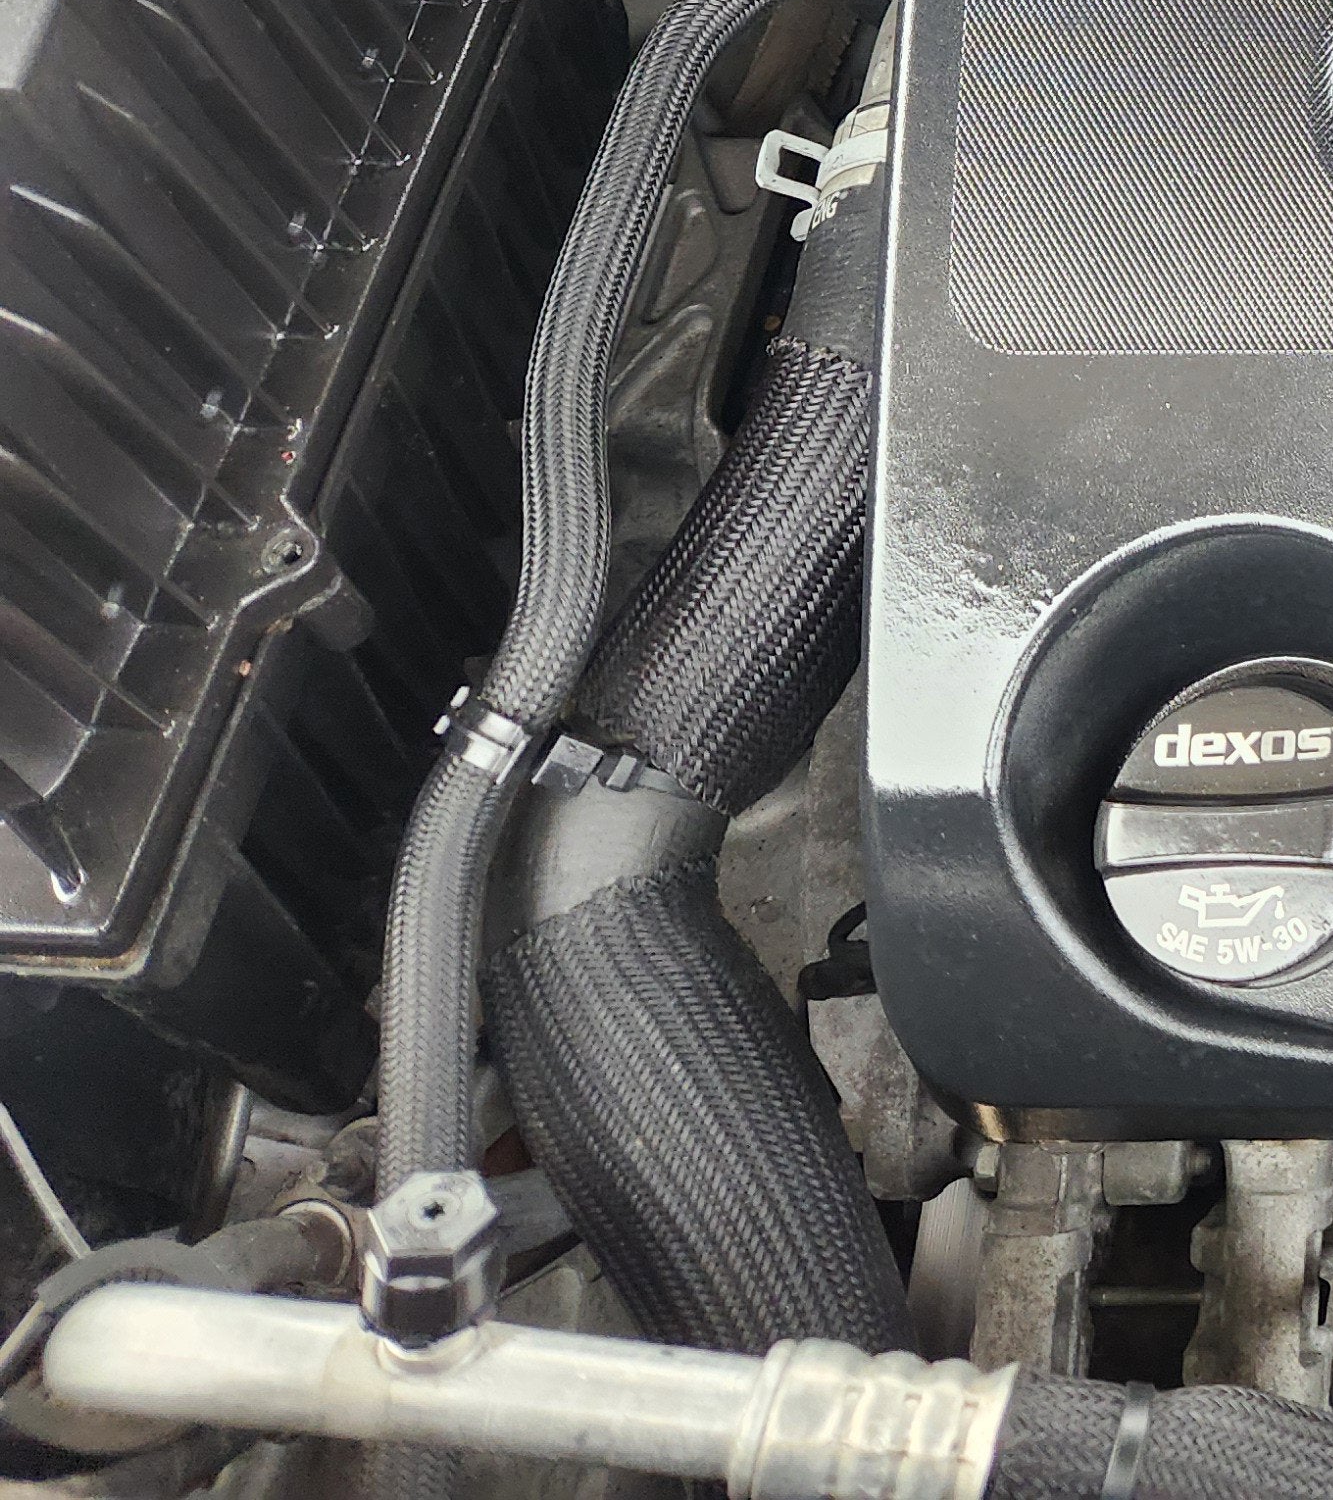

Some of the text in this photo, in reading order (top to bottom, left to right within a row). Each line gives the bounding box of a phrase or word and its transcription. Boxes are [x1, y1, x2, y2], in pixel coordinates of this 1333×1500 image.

[1154, 724, 1333, 767] dexos
[1157, 918, 1307, 965] SAE 5W-30
